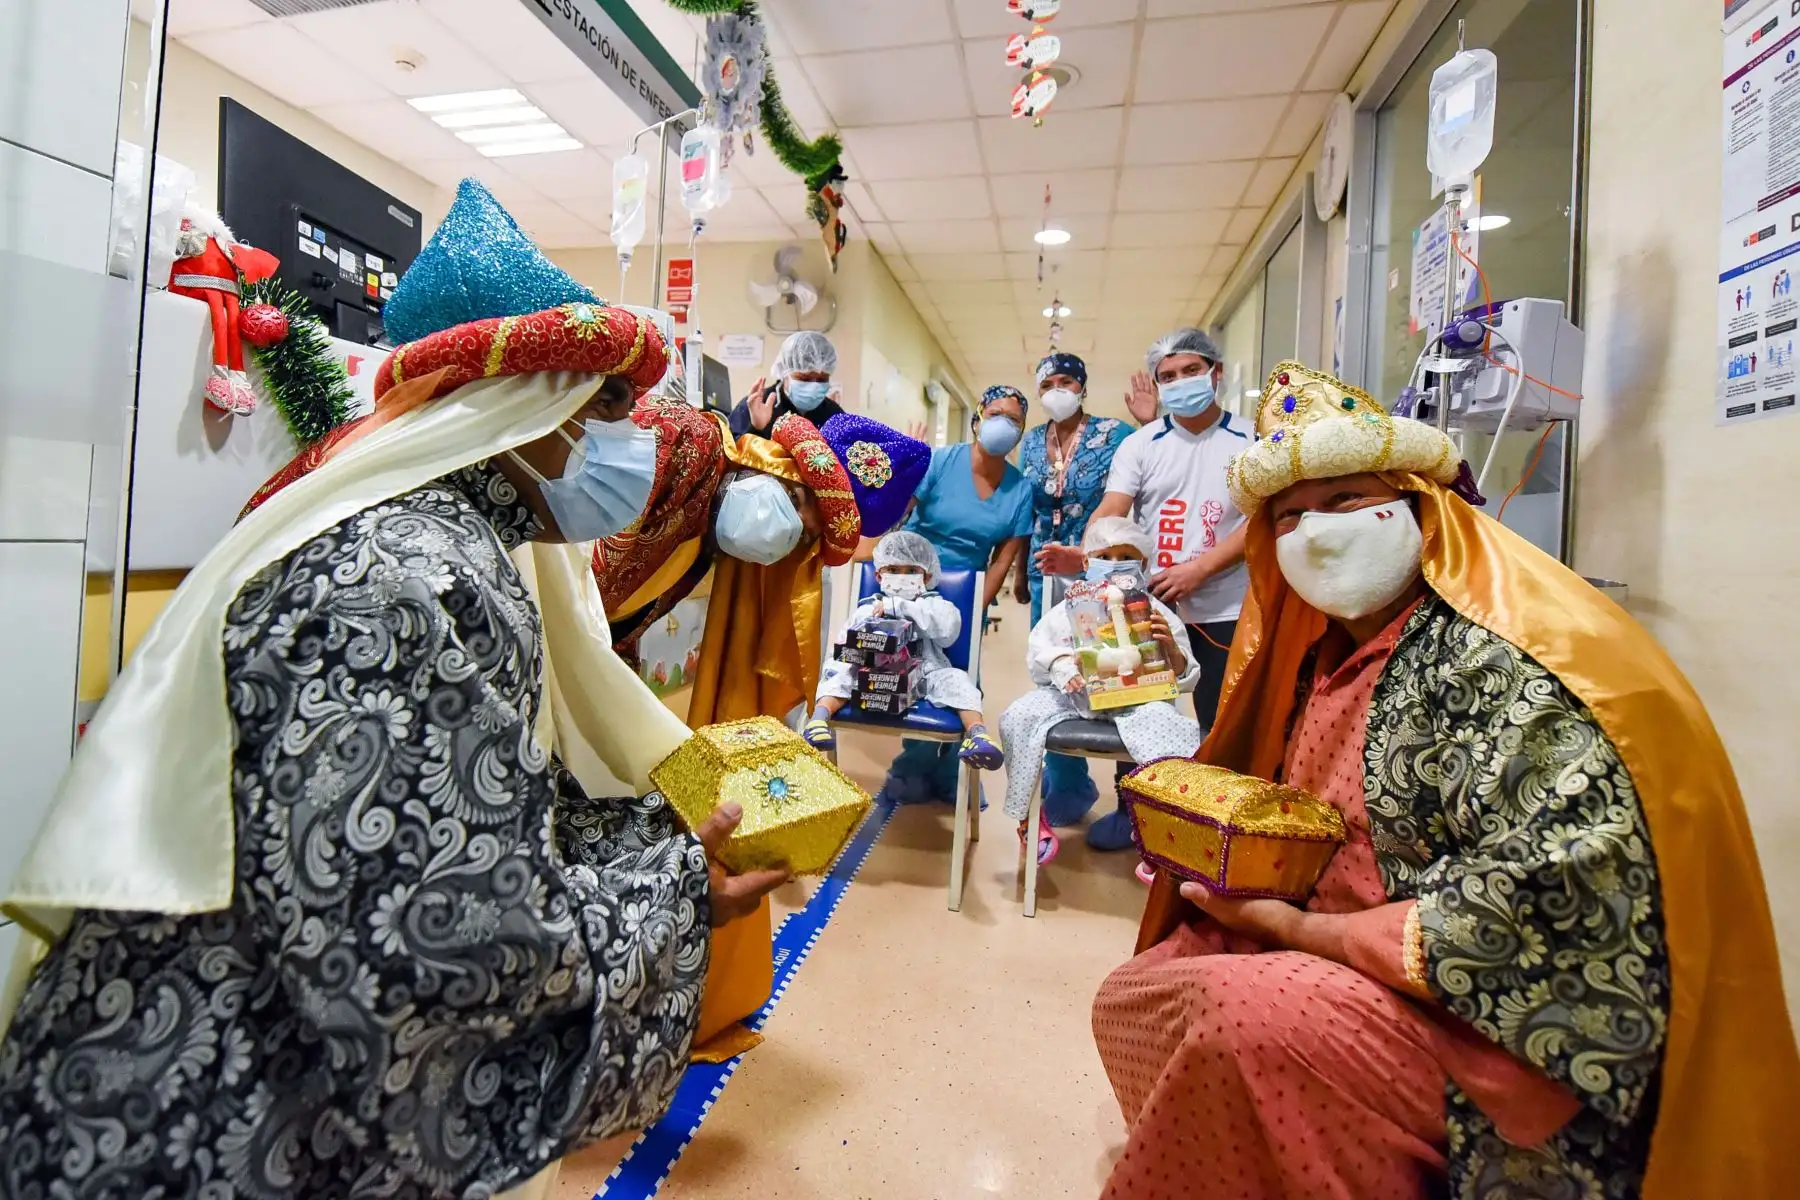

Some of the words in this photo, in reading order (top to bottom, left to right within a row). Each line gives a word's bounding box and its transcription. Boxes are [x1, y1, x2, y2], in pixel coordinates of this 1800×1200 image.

[621, 59, 637, 88] DE
[1157, 499, 1187, 568] PERU
[856, 632, 888, 642] RANGERS
[862, 640, 886, 651] POWER
[868, 673, 900, 682] RANGERS
[874, 681, 897, 692] POWER
[860, 692, 892, 702] RANGERS
[866, 700, 889, 711] POWER
